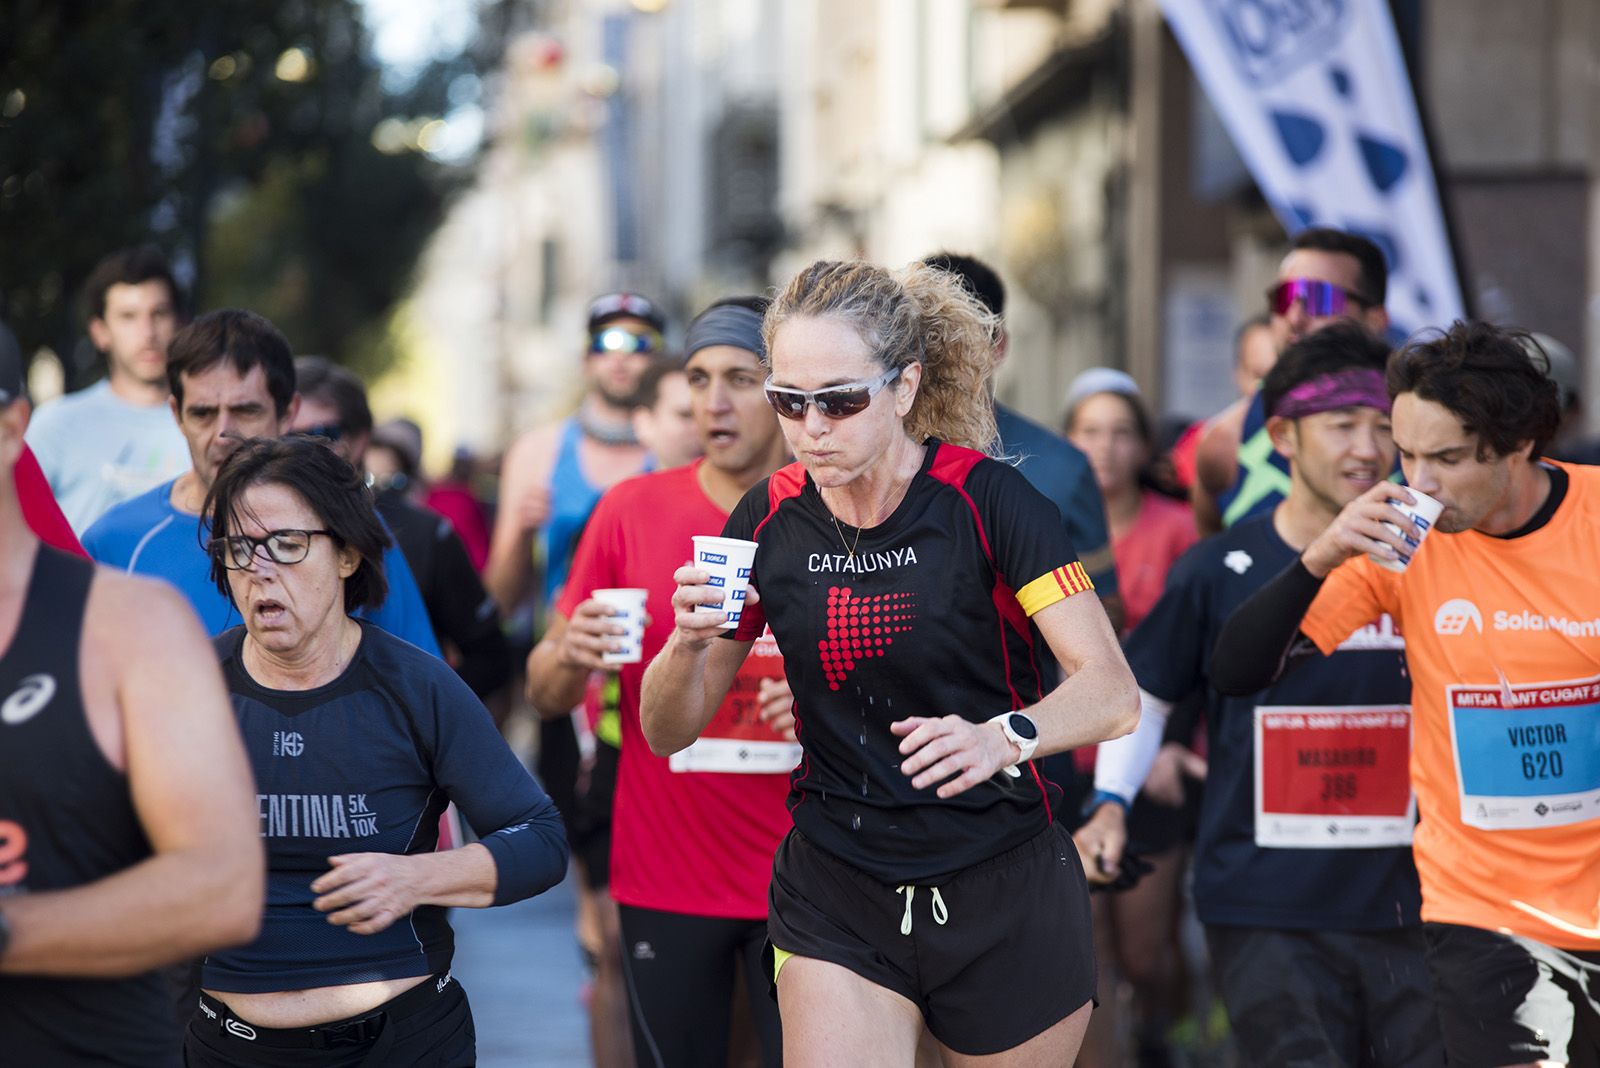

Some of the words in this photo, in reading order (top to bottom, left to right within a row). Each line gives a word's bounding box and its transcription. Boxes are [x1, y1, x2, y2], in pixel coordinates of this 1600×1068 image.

[808, 546, 918, 573] CATALUNYA
[1493, 610, 1600, 638] SolaMent
[1457, 693, 1498, 706] MITJA
[1500, 691, 1537, 706] ANT
[1540, 686, 1589, 704] CUGAT
[1508, 723, 1567, 747] VICTOR
[1522, 750, 1563, 780] 620
[348, 793, 369, 813] 5K
[350, 816, 380, 838] 10K
